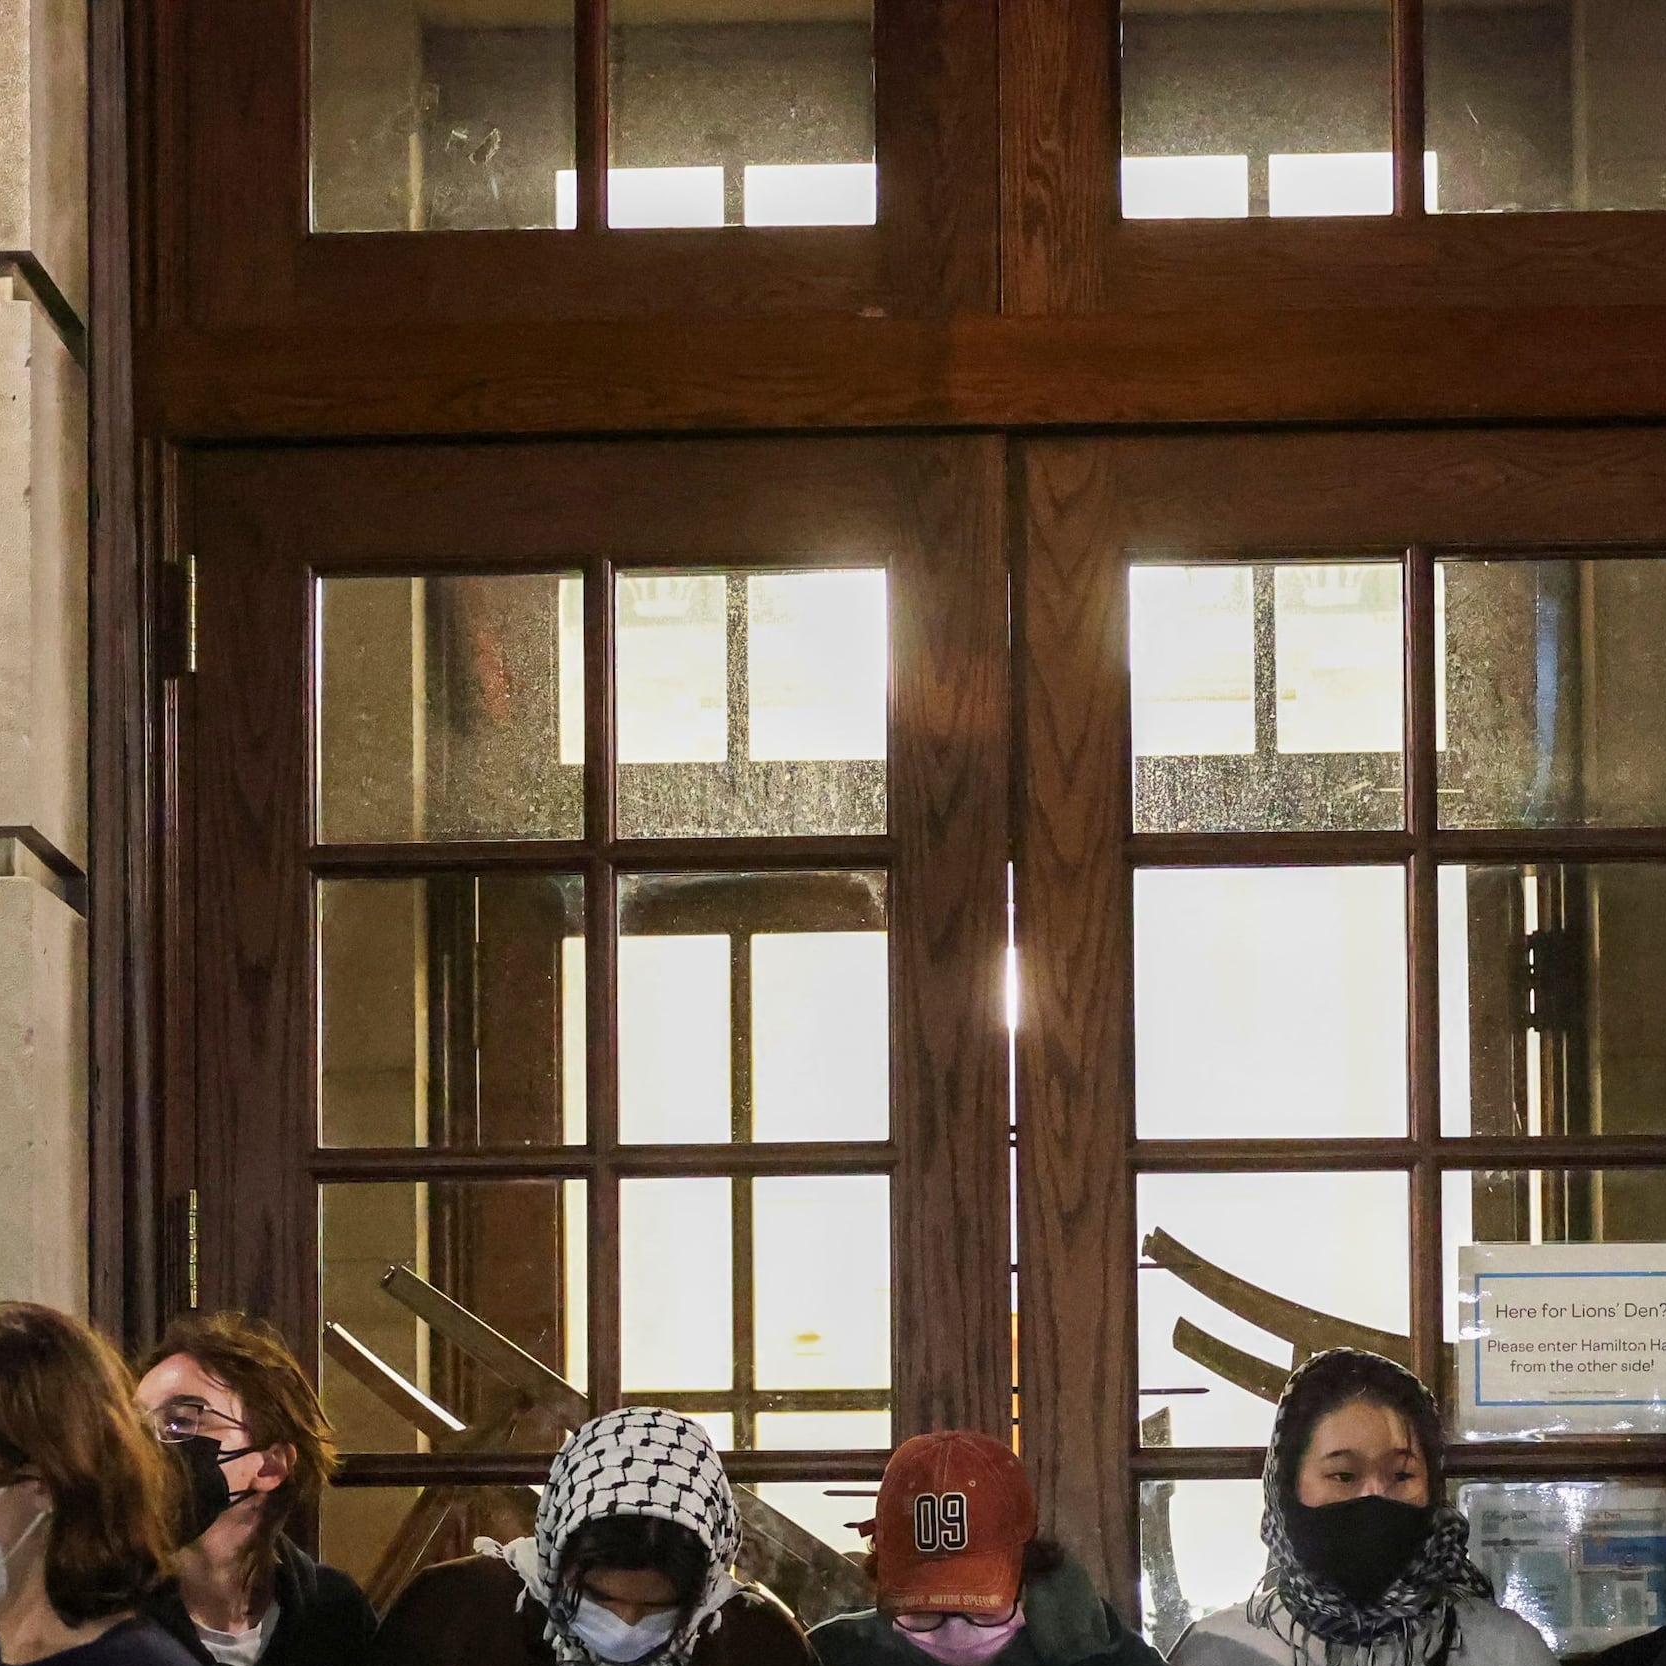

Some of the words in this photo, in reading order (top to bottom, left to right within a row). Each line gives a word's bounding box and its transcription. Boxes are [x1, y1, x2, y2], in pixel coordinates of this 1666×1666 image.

[1495, 1304, 1537, 1319] Here
[1542, 1303, 1568, 1318] for
[1487, 1339, 1535, 1353] Please
[1537, 1341, 1578, 1352] enter
[1581, 1338, 1647, 1352] Hamilton
[1510, 1360, 1546, 1373] from
[1550, 1359, 1574, 1372] the
[1577, 1359, 1618, 1372] other
[1620, 1358, 1655, 1372] side!
[915, 1492, 968, 1552] 09
